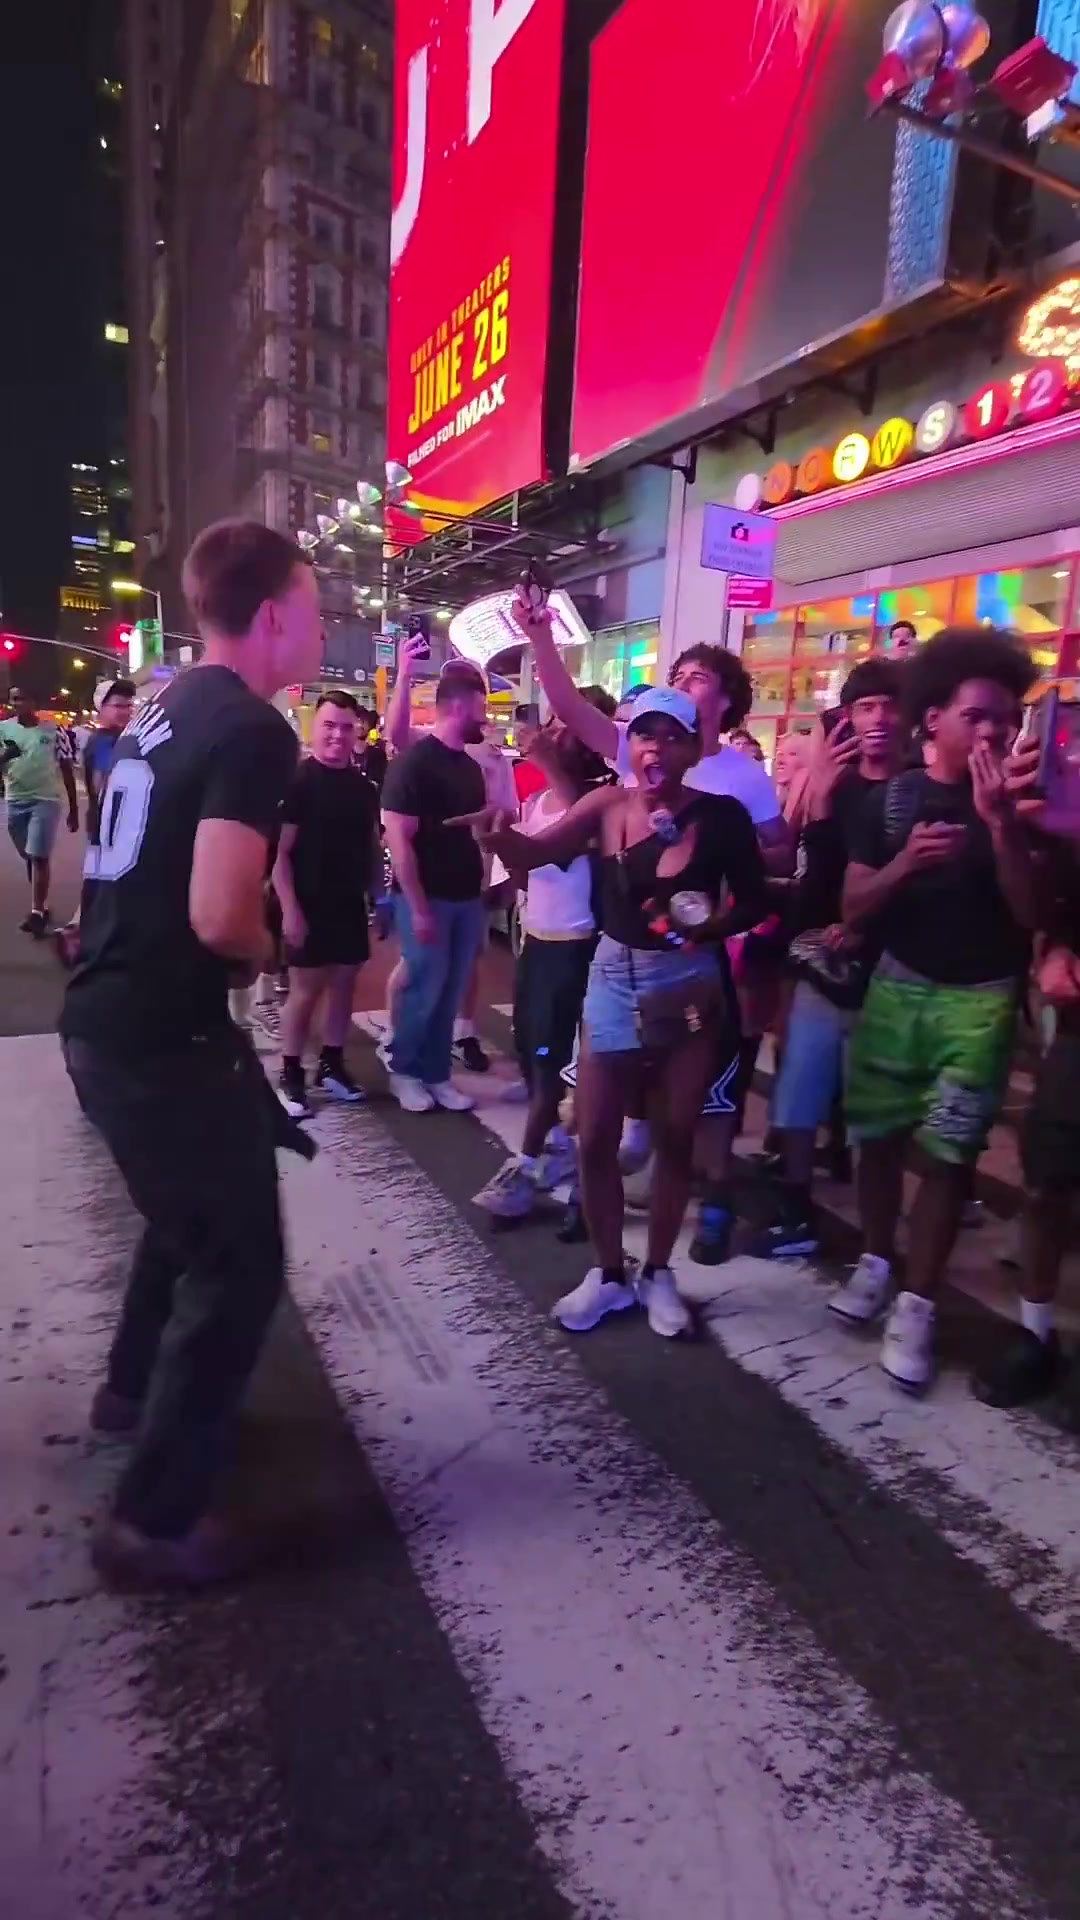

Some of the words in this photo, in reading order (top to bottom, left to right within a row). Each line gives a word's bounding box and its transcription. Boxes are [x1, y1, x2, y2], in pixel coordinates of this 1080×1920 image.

[408, 331, 464, 435] JUNE
[473, 289, 509, 381] 26
[410, 336, 433, 374] ONLY
[436, 320, 448, 349] IN
[452, 255, 510, 332] THEATERS
[407, 436, 436, 468] FILMED
[437, 420, 455, 447] FOR
[456, 373, 508, 437] IMAX
[878, 426, 904, 465] W
[921, 407, 946, 445] S
[976, 389, 994, 427] 1
[1024, 369, 1054, 412] 2
[83, 757, 155, 881] 0
